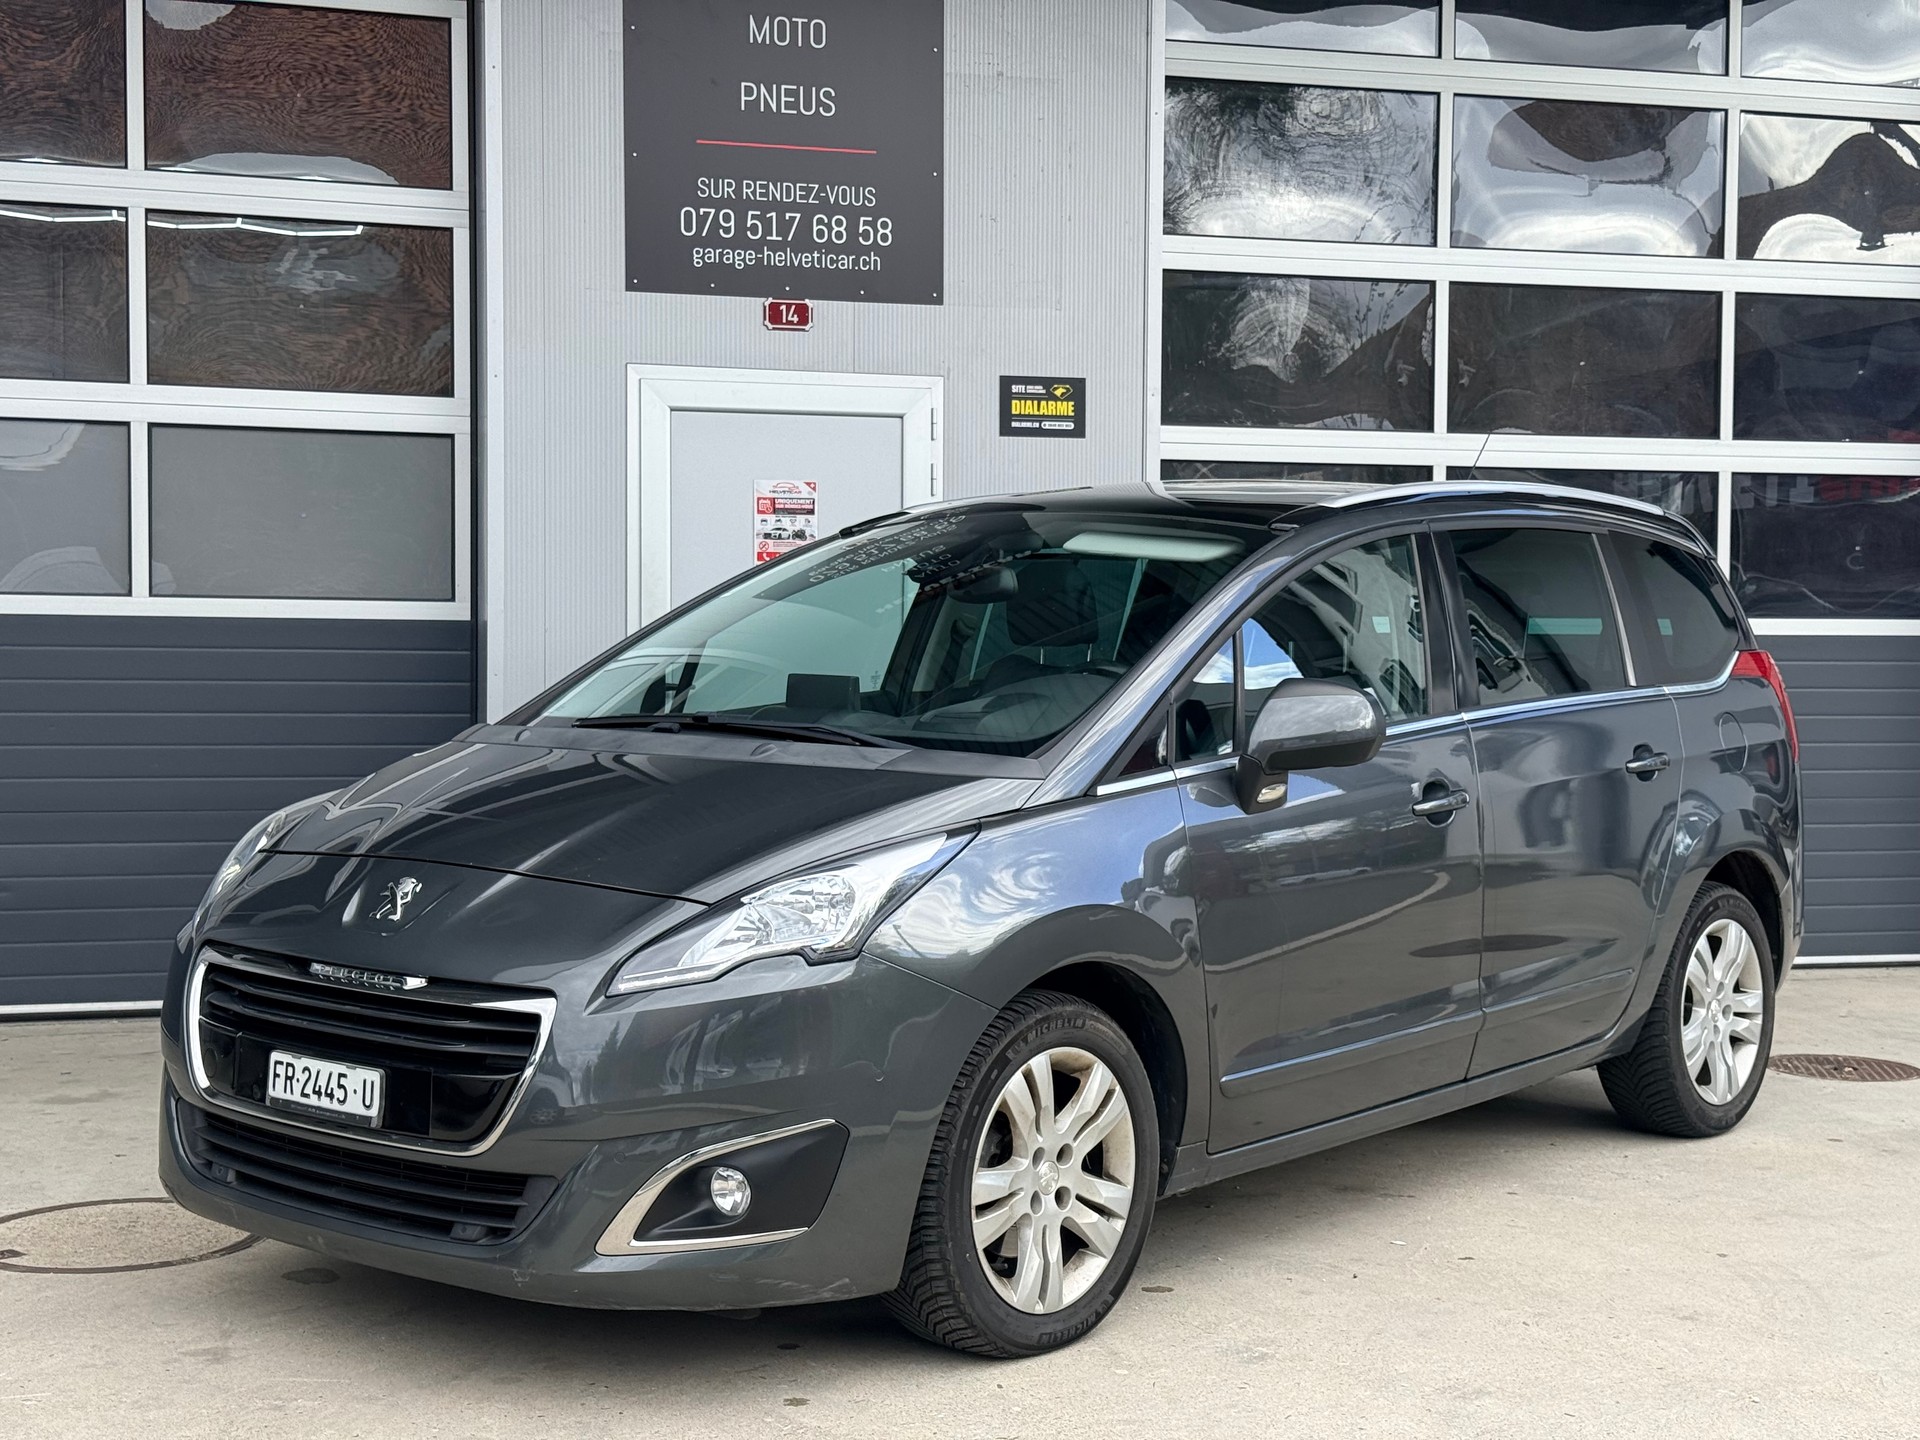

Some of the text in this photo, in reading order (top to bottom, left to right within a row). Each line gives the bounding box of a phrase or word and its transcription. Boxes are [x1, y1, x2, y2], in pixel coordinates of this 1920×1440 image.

[749, 14, 827, 49] MOTO
[740, 81, 836, 116] PNEUS
[697, 177, 876, 207] SUR RENDEZ-VOUS
[680, 206, 893, 247] 079 517 68 58
[693, 246, 881, 271] garage-helveticar.ch
[780, 305, 799, 323] 14
[1011, 385, 1026, 393] SITE
[1011, 400, 1075, 416] DIALARME
[318, 963, 397, 986] PEUGEOT
[1027, 1018, 1084, 1042] MICHELIN
